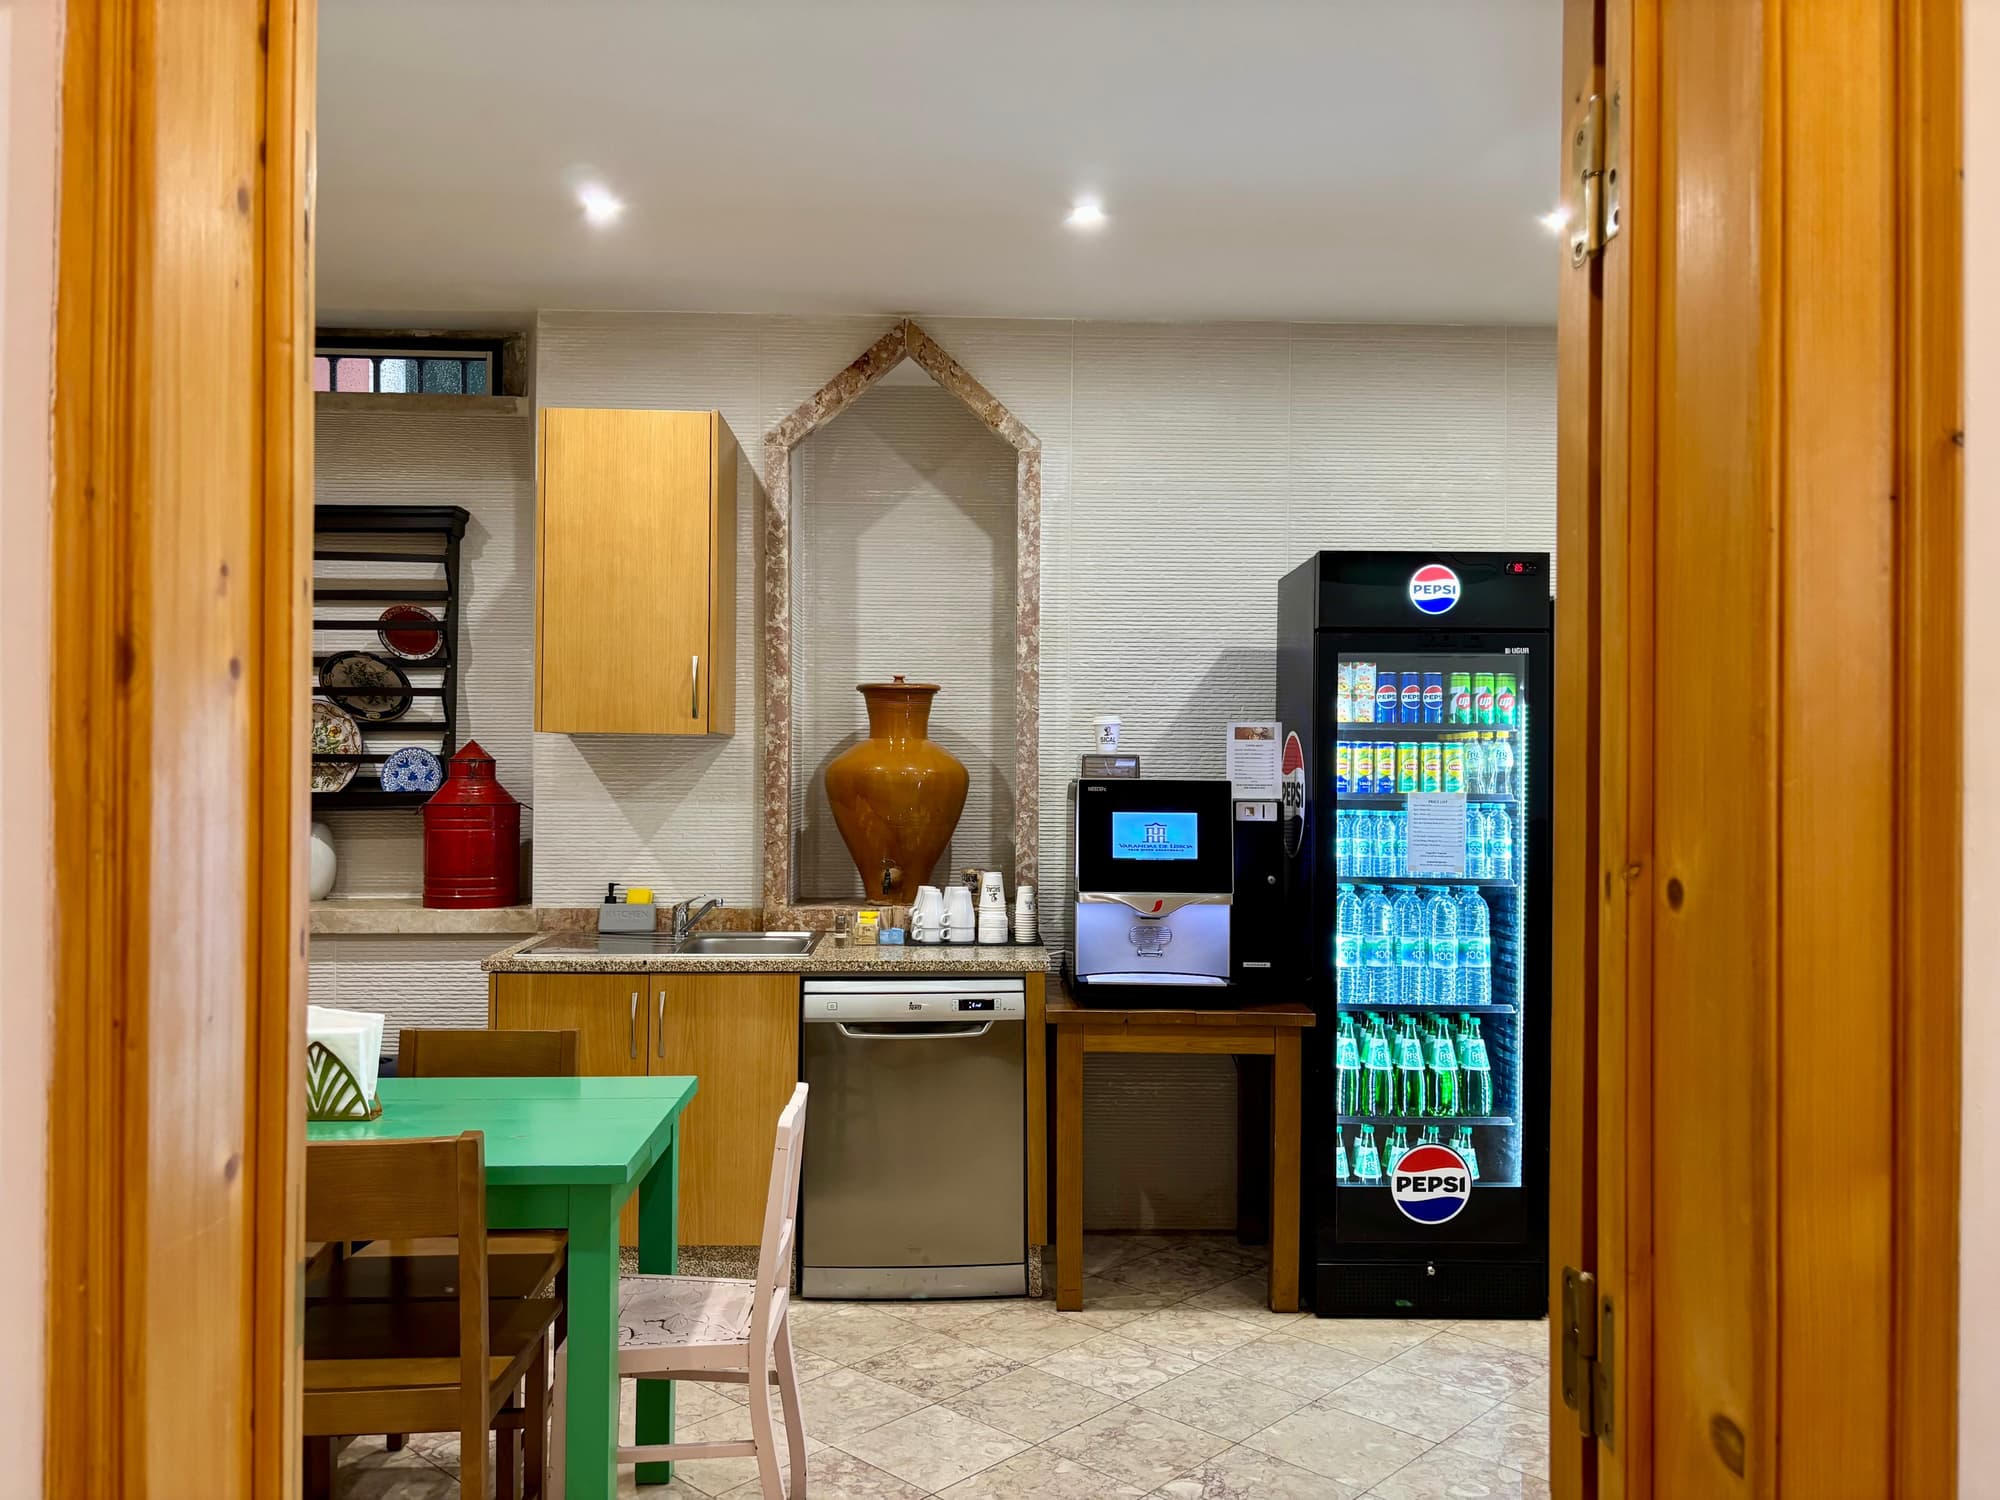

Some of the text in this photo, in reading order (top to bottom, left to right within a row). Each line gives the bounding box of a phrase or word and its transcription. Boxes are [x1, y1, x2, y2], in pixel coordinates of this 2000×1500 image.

[1413, 584, 1456, 595] PEPSI
[1282, 781, 1304, 809] PEPSI
[1396, 1176, 1466, 1193] PEPSI
